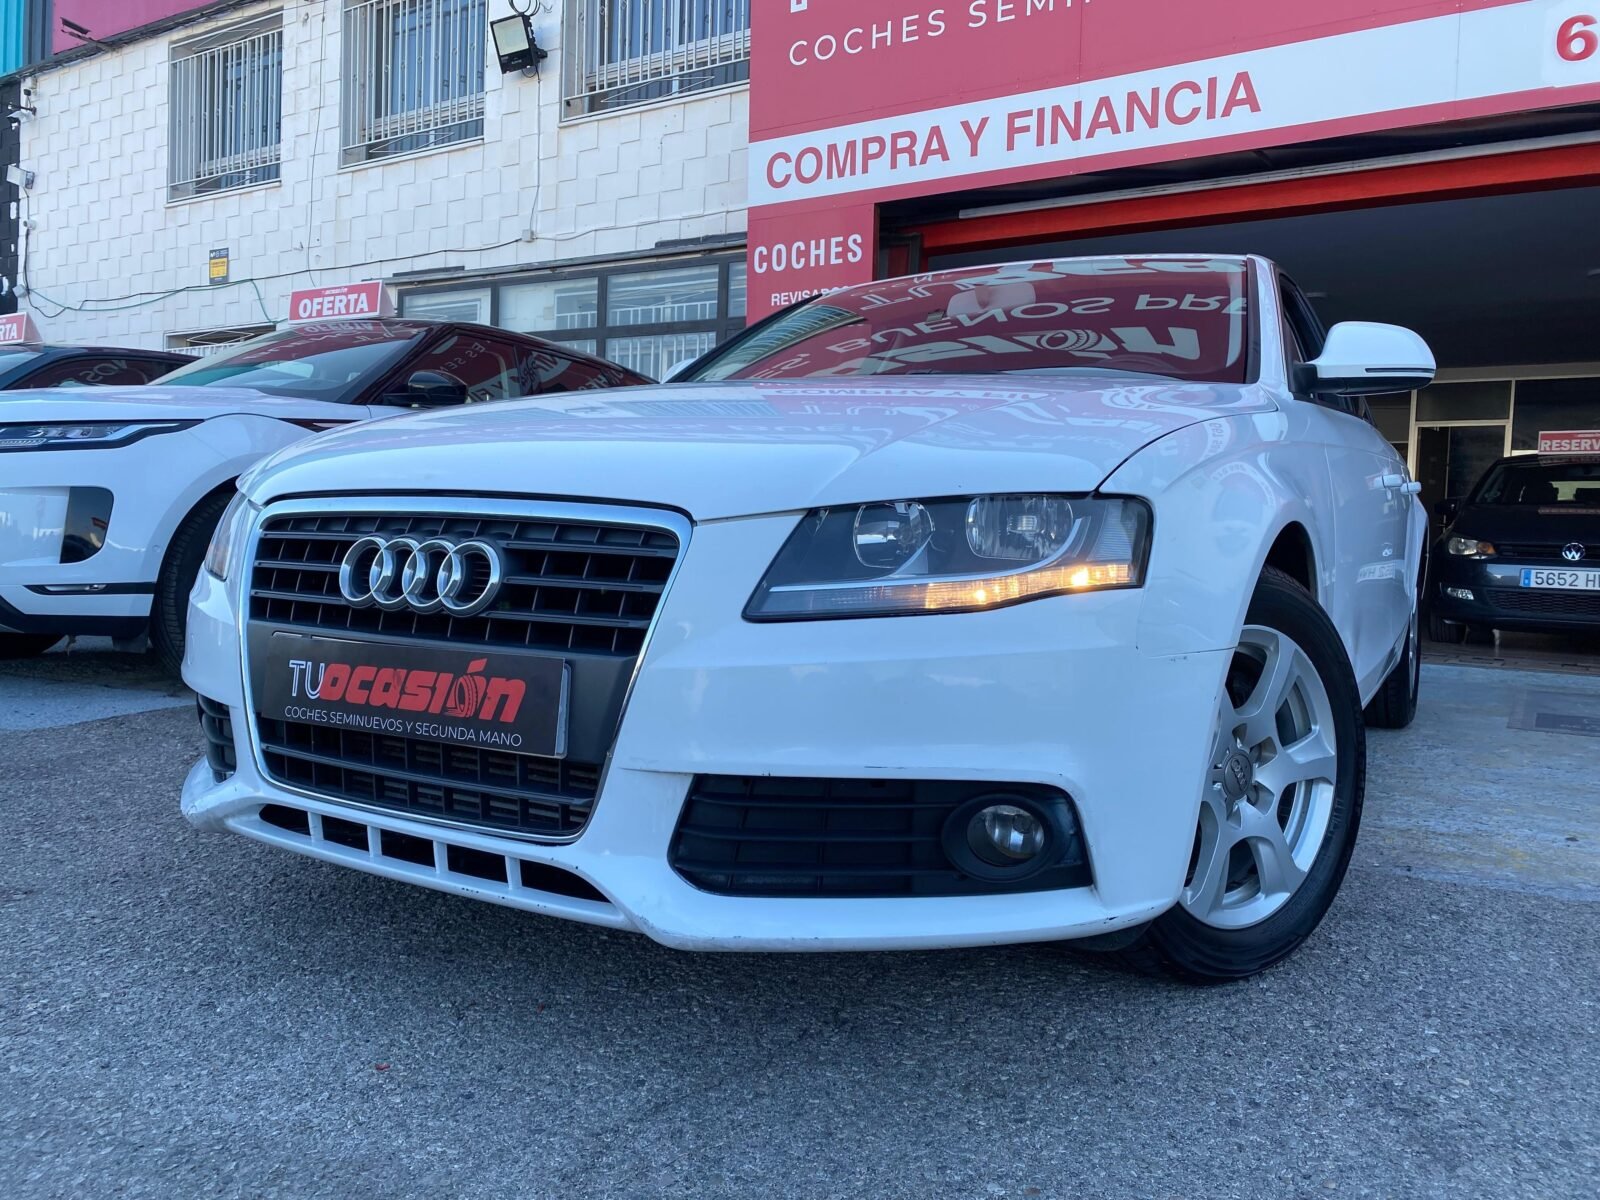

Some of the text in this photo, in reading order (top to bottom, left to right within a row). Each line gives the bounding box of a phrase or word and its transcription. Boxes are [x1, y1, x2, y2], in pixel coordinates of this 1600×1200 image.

[789, 9, 946, 65] COCHES
[766, 71, 1262, 189] COMPRA Y FINANCIA
[753, 233, 863, 274] COCHES
[298, 292, 369, 319] OFERTA
[1535, 571, 1579, 587] 5652
[284, 705, 522, 748] COCHES SEMINUEVOS Y SEGUNDA MANO
